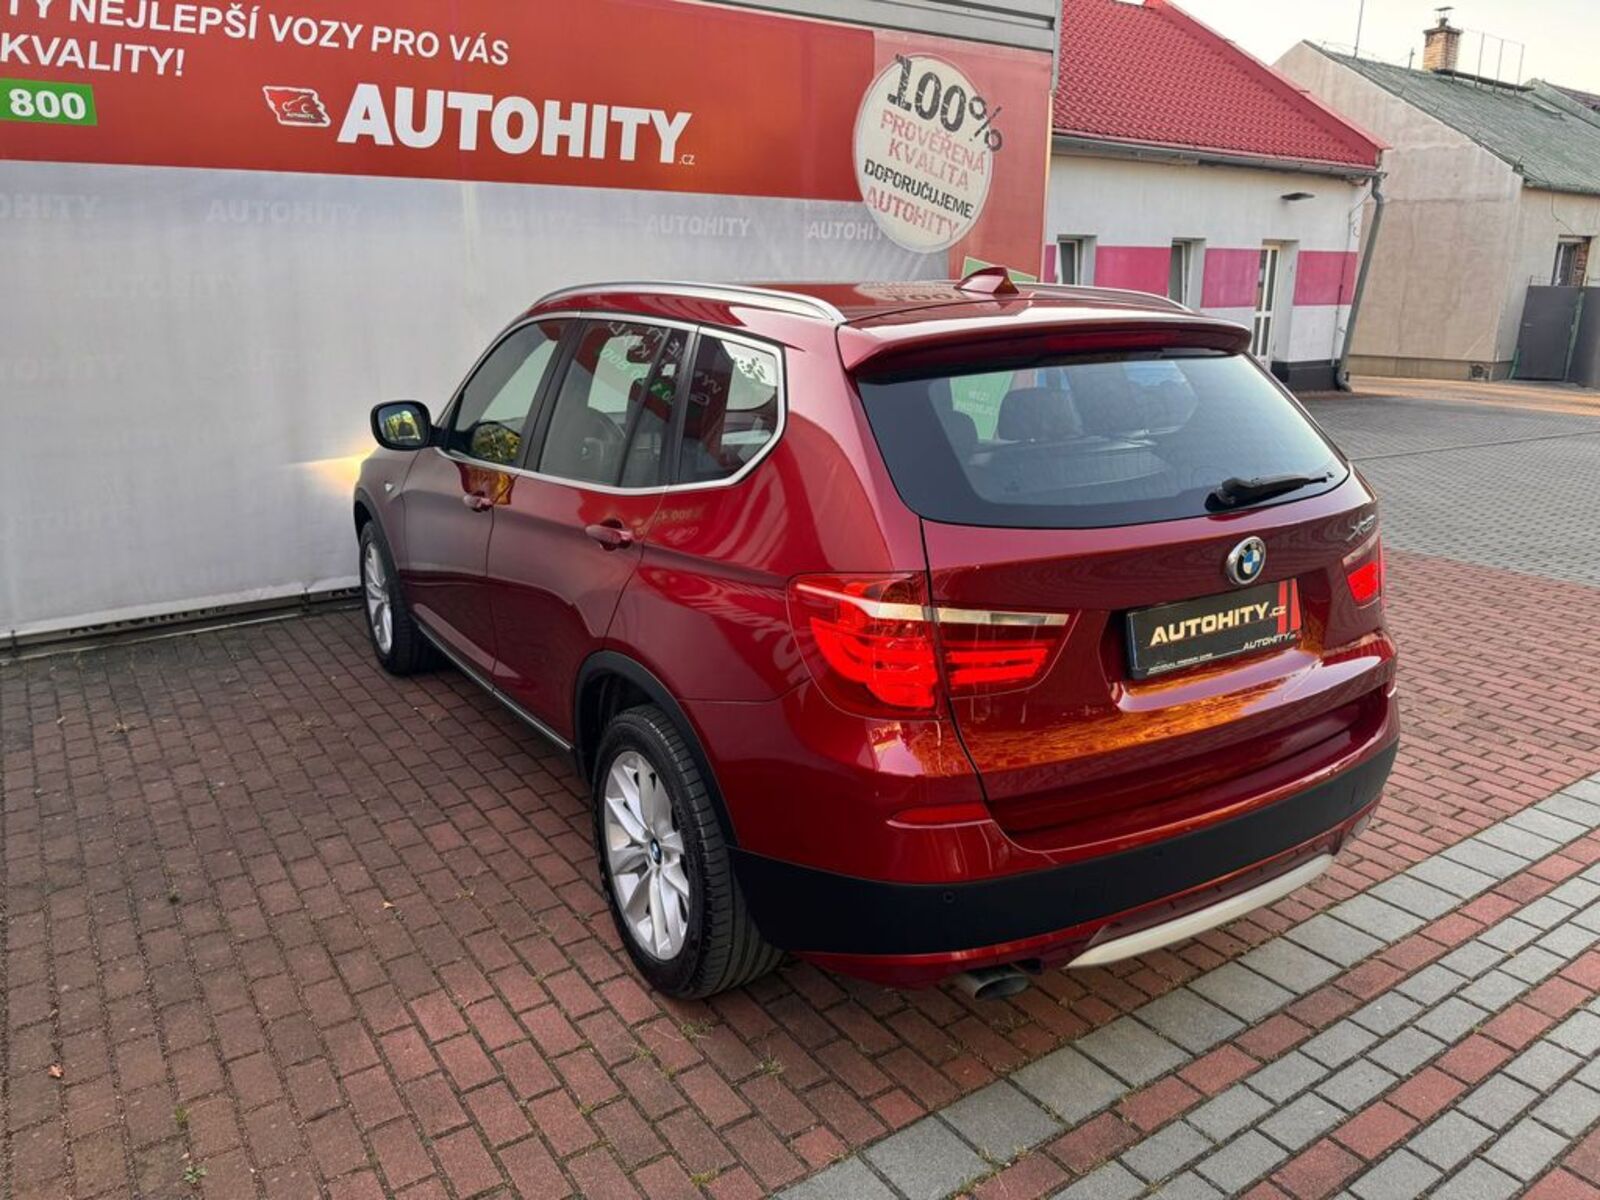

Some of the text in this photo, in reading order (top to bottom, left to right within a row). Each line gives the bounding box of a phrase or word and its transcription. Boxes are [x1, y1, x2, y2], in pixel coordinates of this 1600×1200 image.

[0, 32, 184, 77] KVALITY!
[69, 0, 260, 40] NEJLEPŠÍ
[268, 14, 363, 49] VOZY
[371, 26, 440, 58] PRO
[450, 32, 510, 66] VÁS
[9, 88, 87, 121] 800
[887, 53, 1003, 152] 100%
[864, 158, 974, 220] DOPORUČUJEME
[888, 138, 970, 191] KVALITA
[646, 213, 750, 238] AUTOHITY
[866, 185, 960, 240] AUTOHITY
